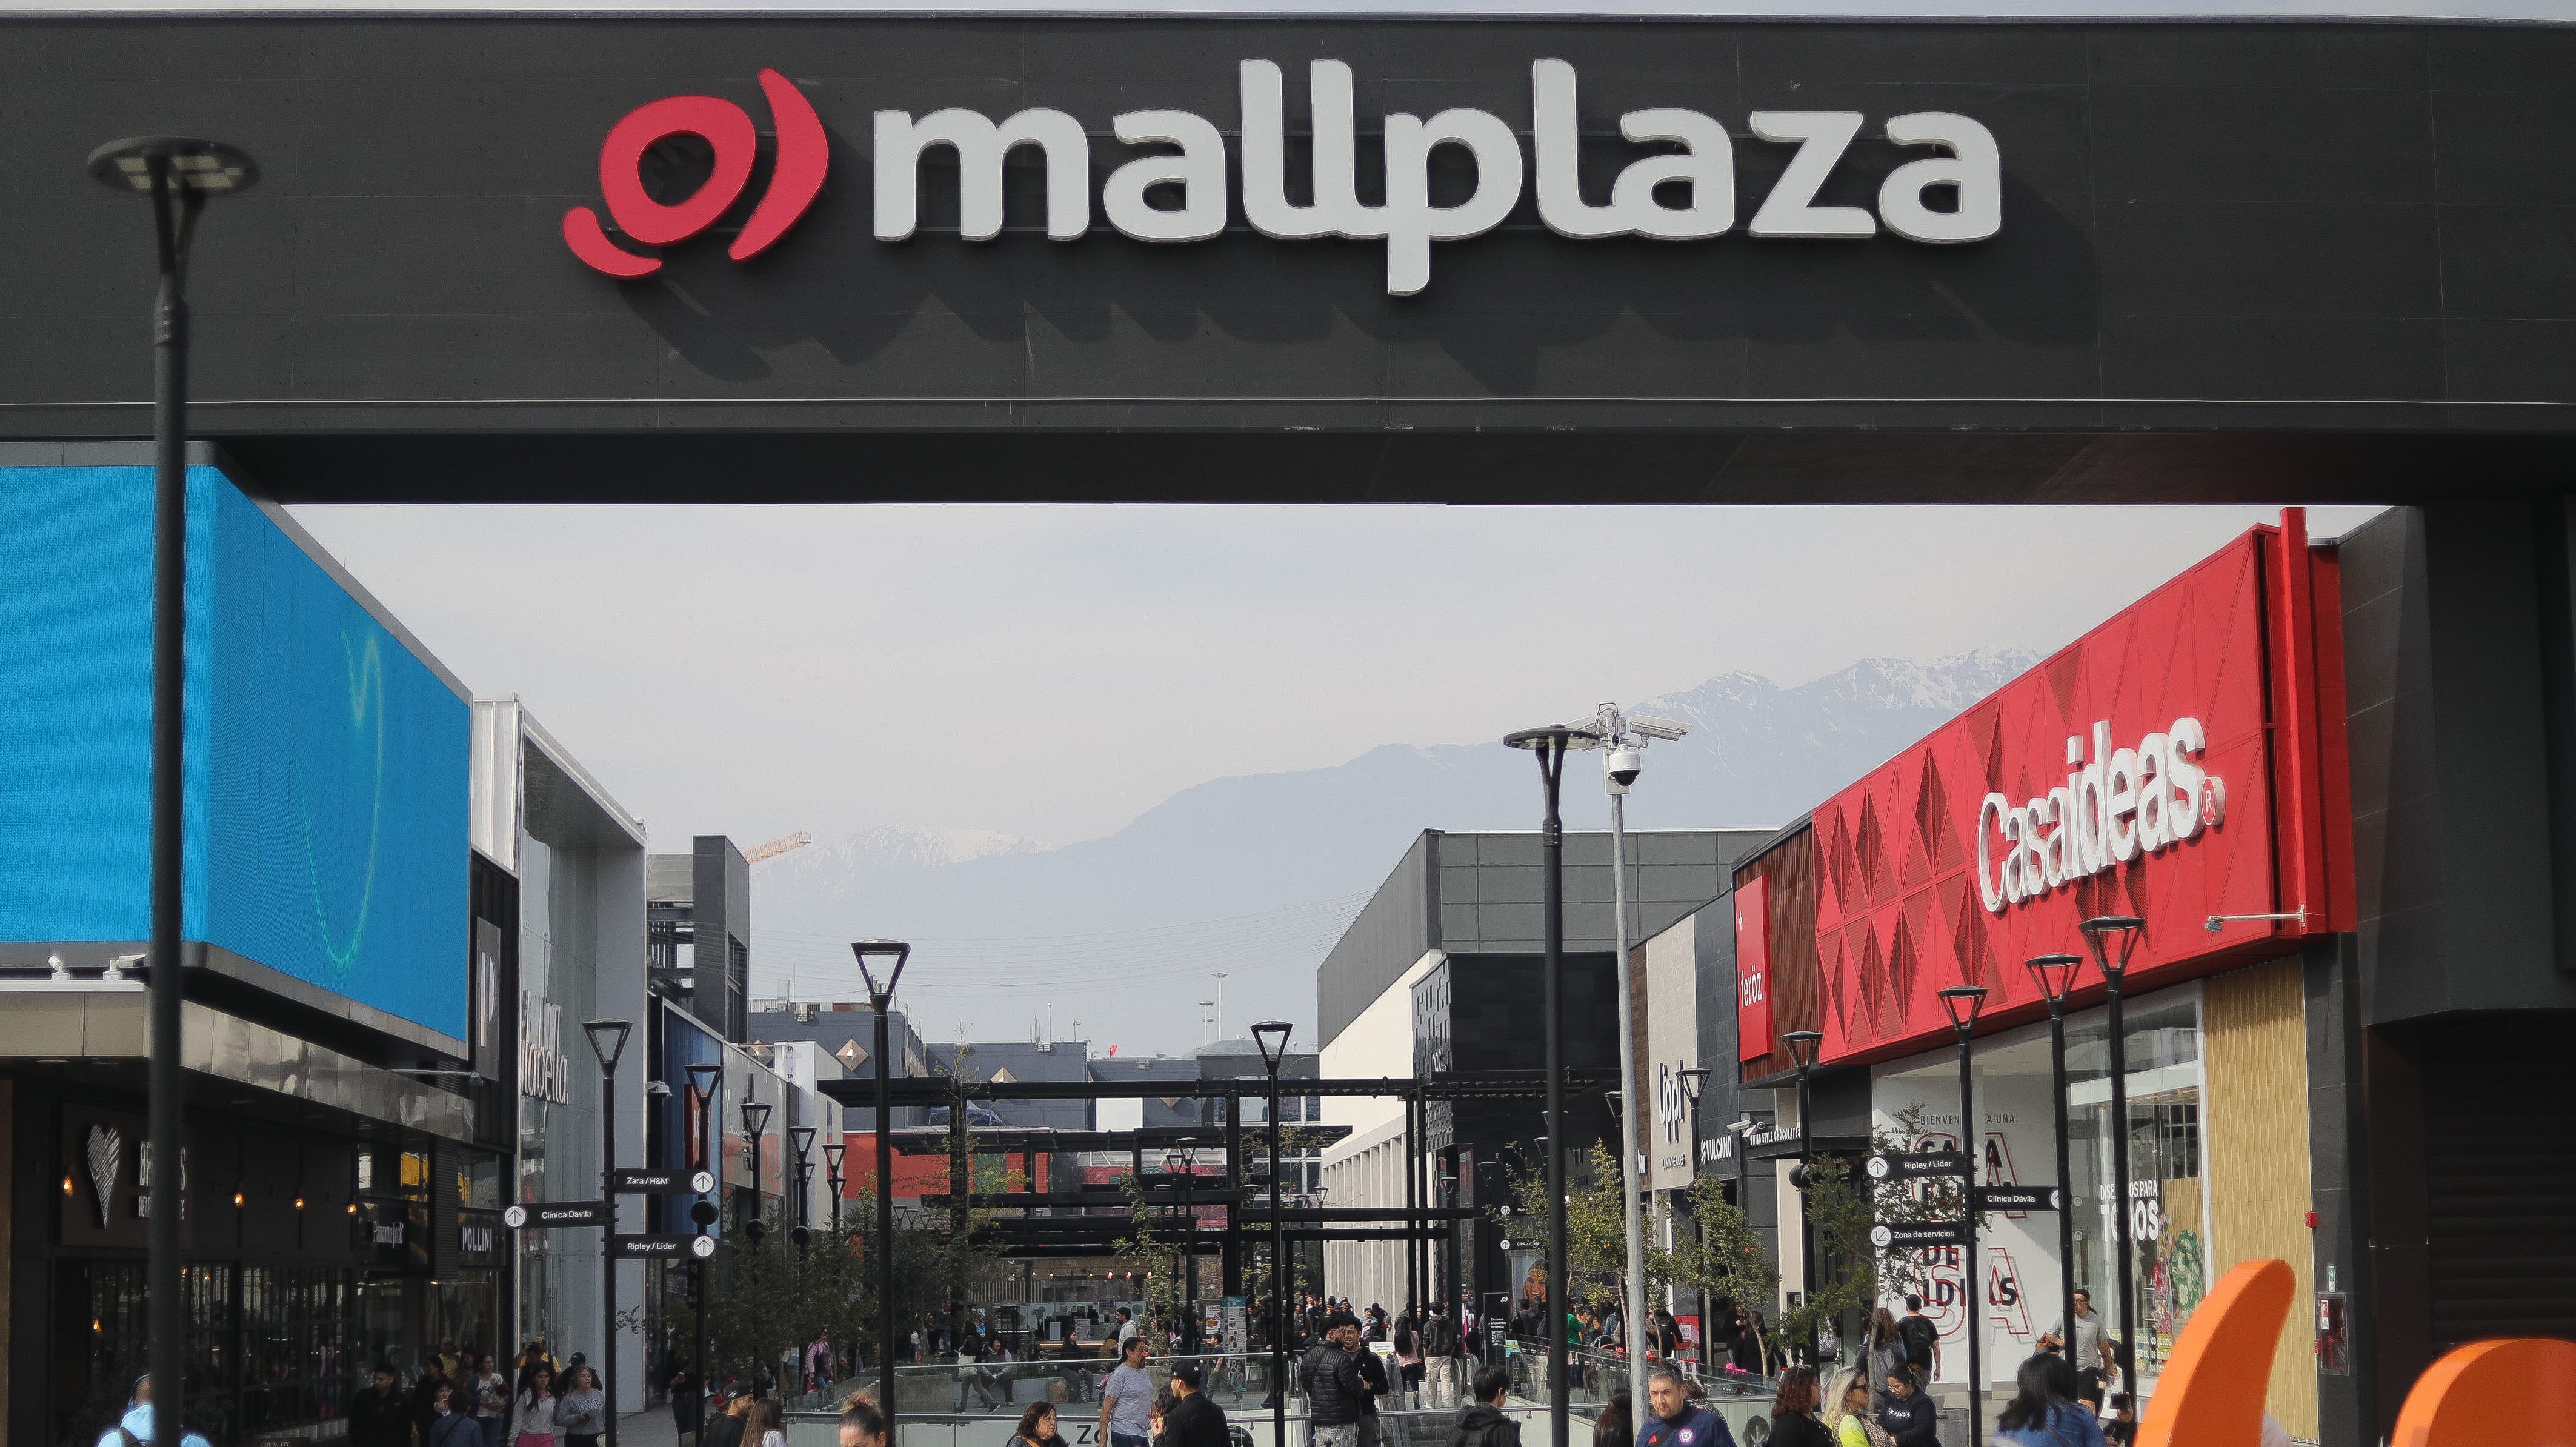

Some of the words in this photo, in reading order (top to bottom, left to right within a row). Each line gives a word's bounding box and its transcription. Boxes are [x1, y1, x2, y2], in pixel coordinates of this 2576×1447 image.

[873, 58, 2003, 296] mallplaza
[1978, 717, 2206, 913] Casaideas
[1741, 963, 1763, 1008] feröz
[1996, 1114, 2015, 1123] UNA
[1706, 1135, 1732, 1161] VULCANO
[627, 1177, 645, 1185] Zara
[2100, 1181, 2138, 1200] DISEOS
[2139, 1180, 2158, 1198] PARA
[1987, 1194, 2012, 1203] Clínica
[2012, 1194, 2035, 1203] Dávila
[542, 1211, 567, 1219] Clínica
[2100, 1199, 2159, 1242] TOOS
[462, 1226, 492, 1252] POLLINI
[1923, 1229, 1955, 1238] servicios
[628, 1242, 651, 1251] Ripley
